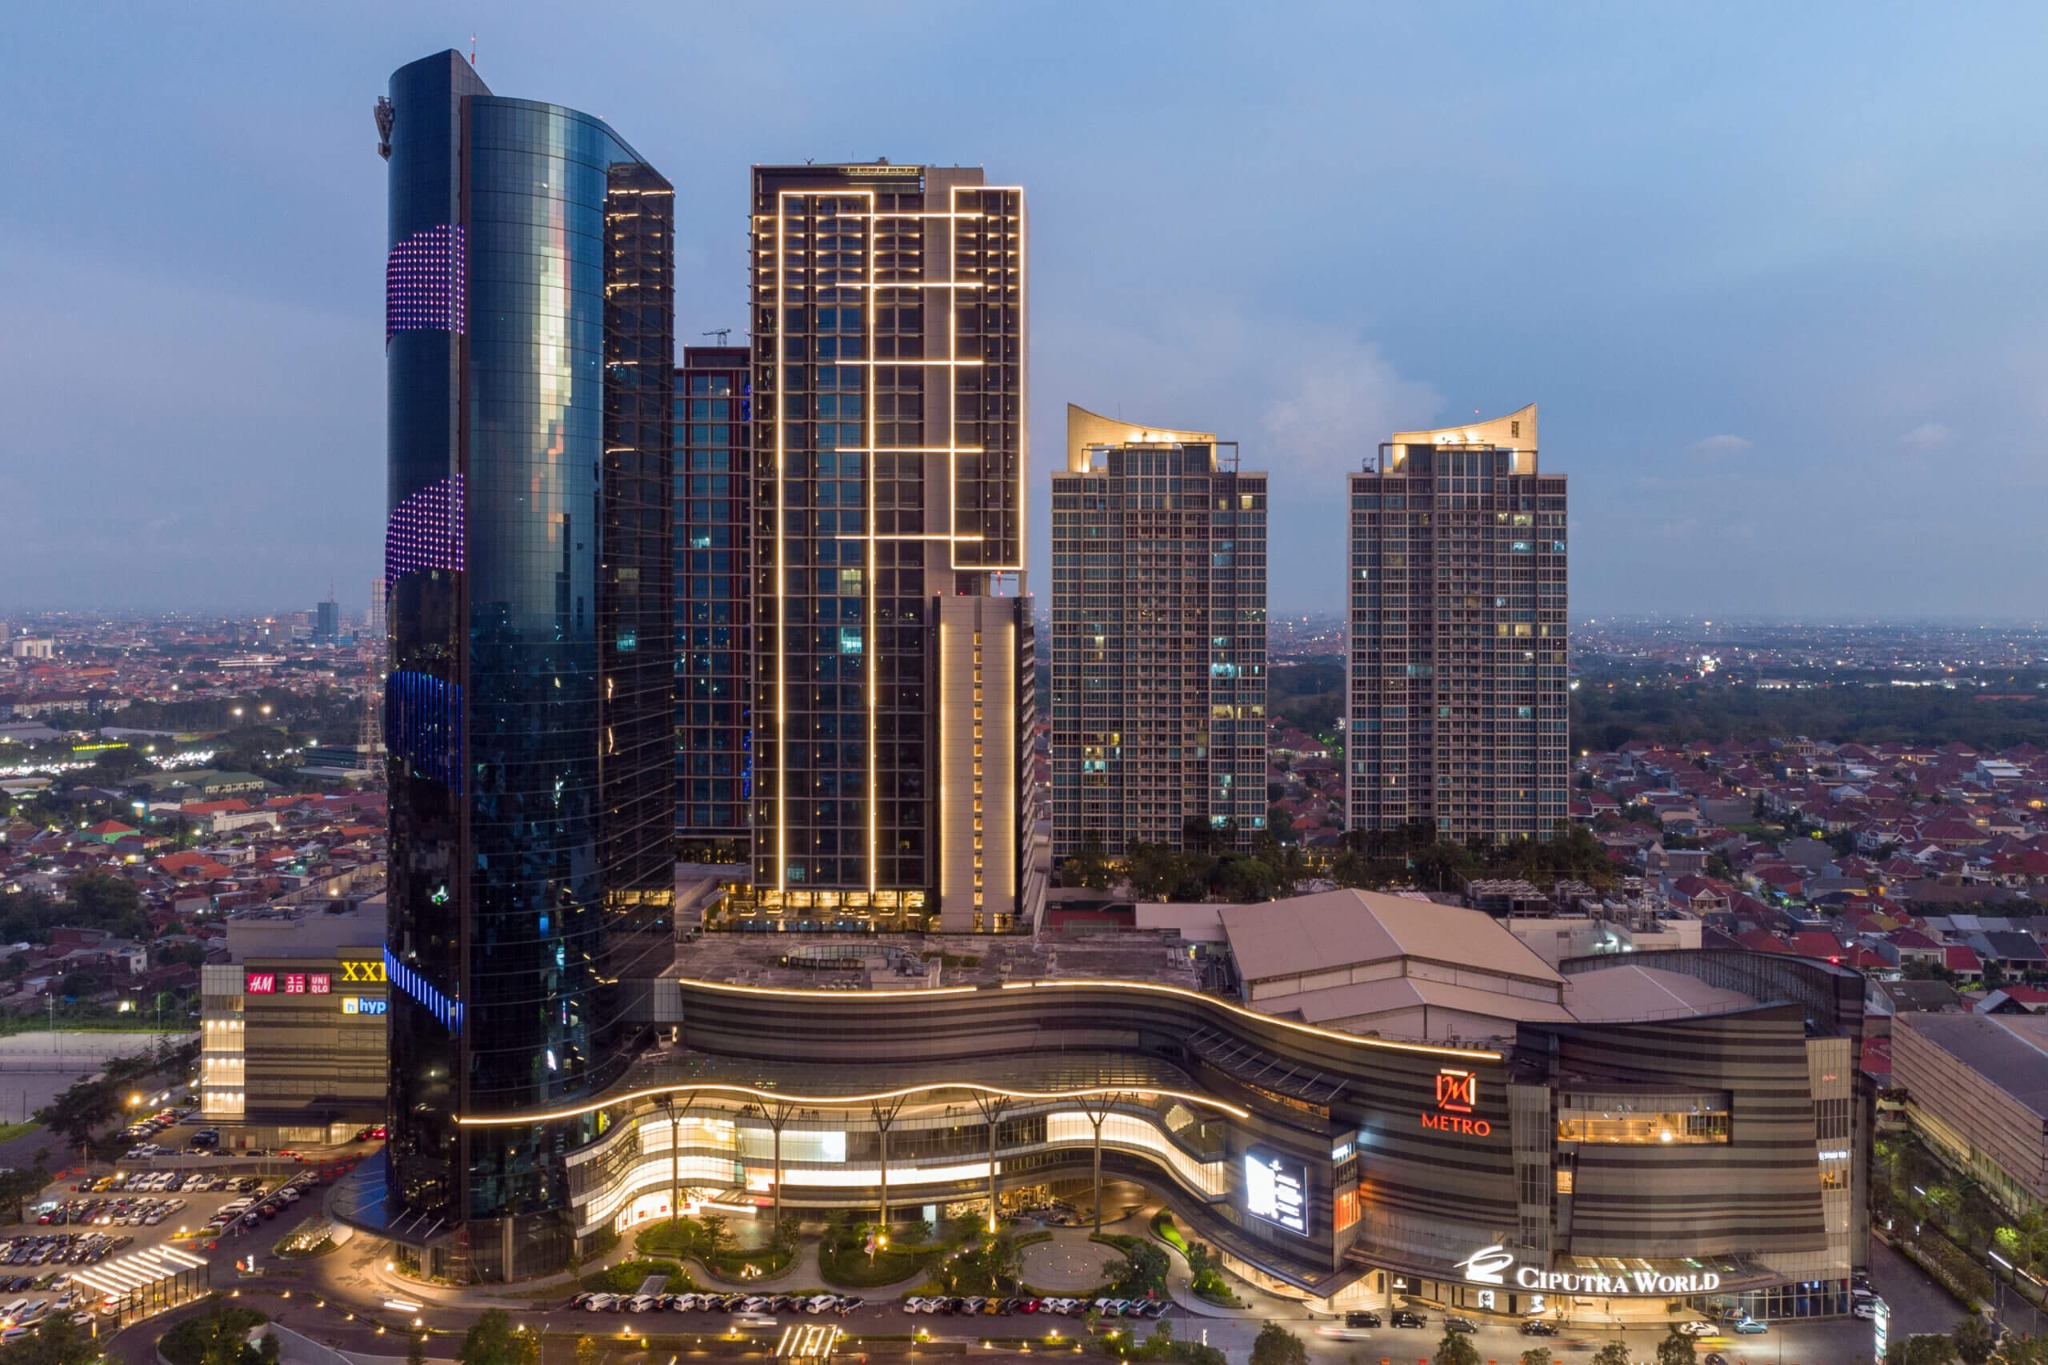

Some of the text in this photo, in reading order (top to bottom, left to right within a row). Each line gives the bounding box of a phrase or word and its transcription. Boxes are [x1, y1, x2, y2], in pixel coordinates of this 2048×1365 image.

[250, 976, 274, 992] H&M
[311, 976, 327, 984] UNI
[311, 985, 328, 994] QLO
[1422, 1111, 1491, 1137] METRO
